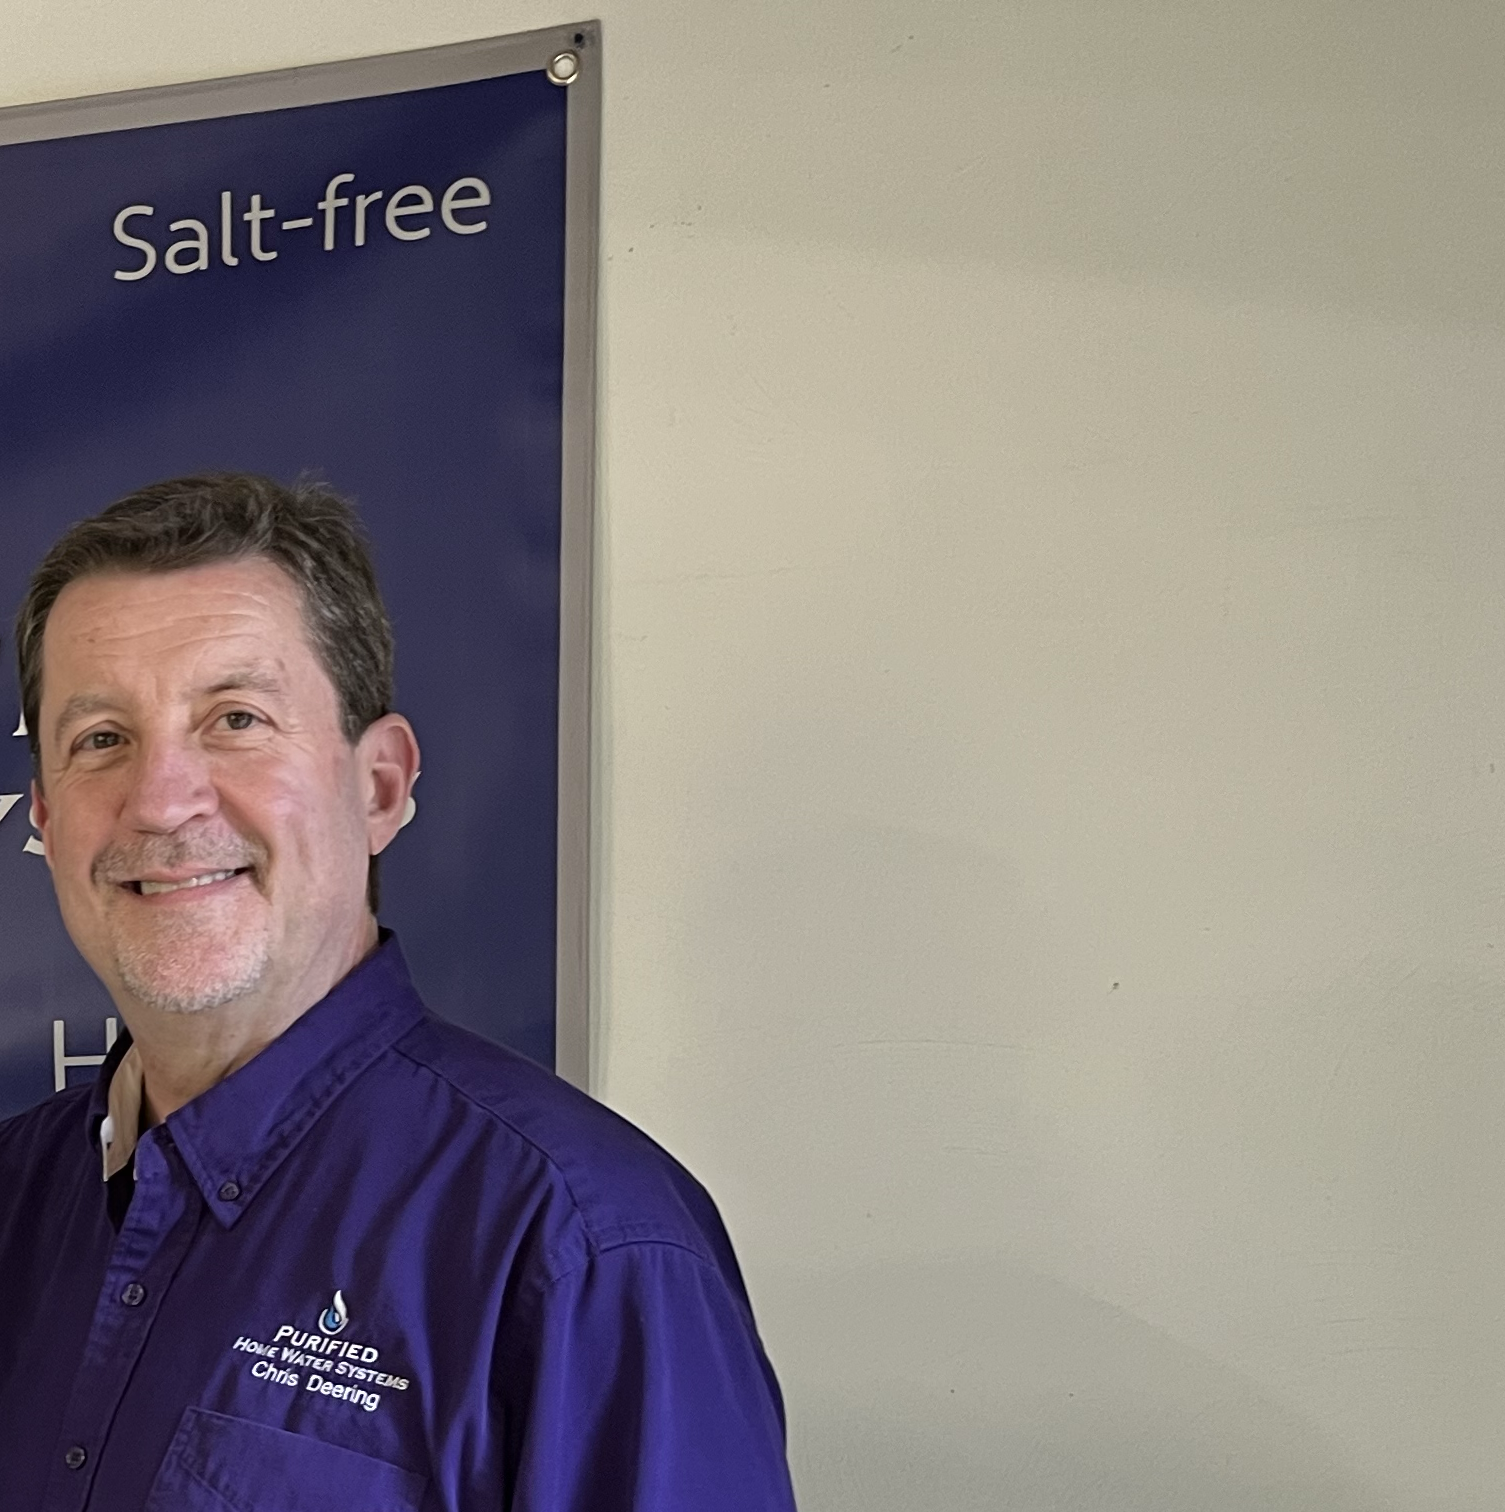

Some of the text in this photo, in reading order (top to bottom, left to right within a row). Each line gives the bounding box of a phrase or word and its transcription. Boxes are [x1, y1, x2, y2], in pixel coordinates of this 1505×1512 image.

[112, 173, 491, 281] Salt-free
[233, 1336, 410, 1391] HOME WATER SYSTEMS
[273, 1325, 379, 1363] PURIFIED
[251, 1360, 381, 1412] Chris Deering
